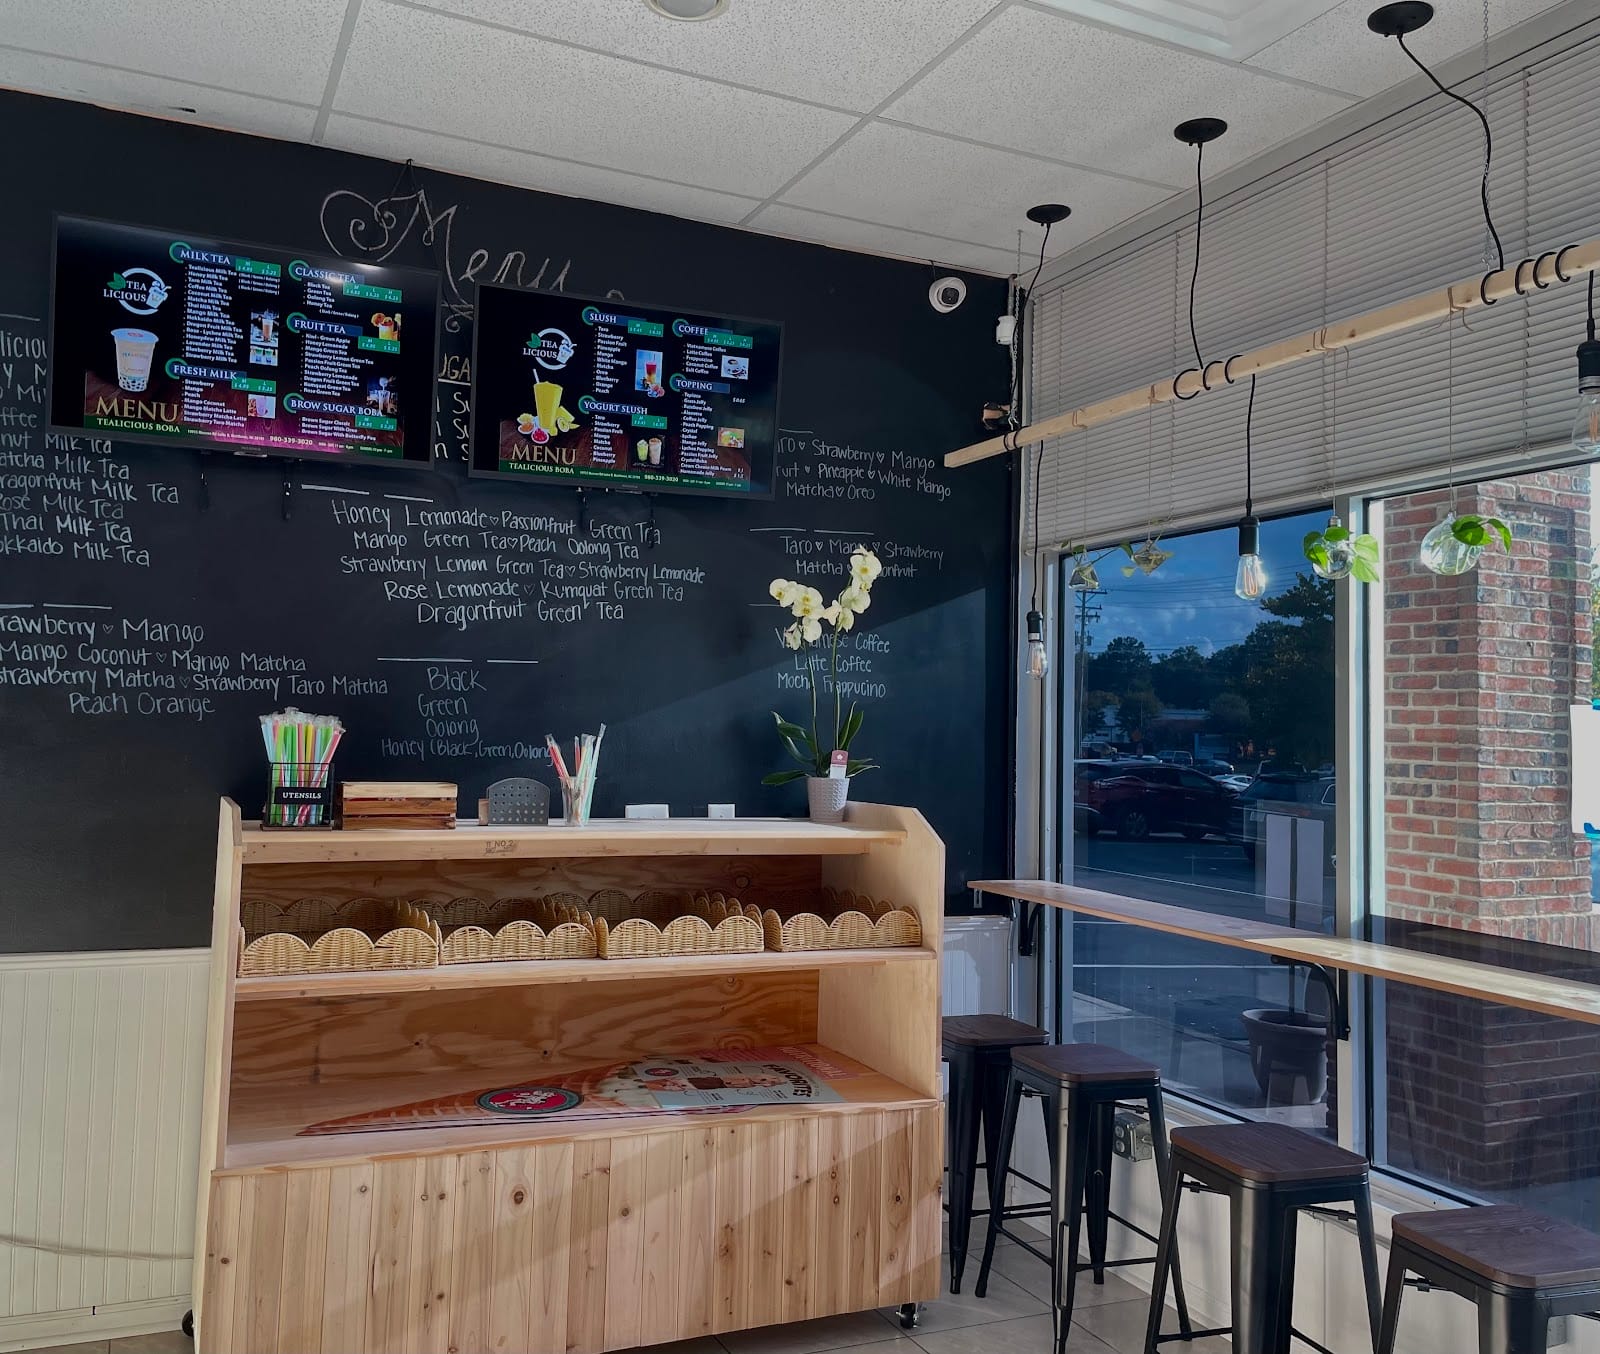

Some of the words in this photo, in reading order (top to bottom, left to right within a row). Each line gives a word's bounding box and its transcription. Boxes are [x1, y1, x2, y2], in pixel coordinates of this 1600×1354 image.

[180, 249, 208, 260] MILK
[210, 253, 230, 264] TEA
[126, 280, 147, 292] TEA
[295, 267, 338, 281] CLASSIC
[338, 273, 356, 284] TEA
[103, 288, 147, 302] LICIOUS
[294, 319, 325, 331] FRUIT
[327, 324, 346, 334] TEA
[589, 312, 617, 324] SLUSH
[678, 324, 709, 336] COFFEE
[523, 347, 558, 359] LICIOUS
[541, 339, 558, 349] TEA
[173, 364, 207, 377] FRESH
[209, 369, 237, 381] MILK
[184, 379, 215, 388] Strawberry
[184, 385, 204, 393] Mango
[675, 379, 713, 391] TOPPING
[95, 395, 180, 423] MENU
[291, 399, 320, 411] BROW
[322, 403, 356, 415] SUGAR
[358, 407, 383, 417] BOBA
[583, 401, 619, 412] YOGURT
[621, 405, 648, 415] SLUSH
[96, 417, 153, 431] TEALICIOUS
[155, 423, 180, 433] BOBA
[511, 443, 577, 465] MENU
[811, 438, 875, 471] Strawberry
[891, 450, 936, 479] Mango
[55, 453, 96, 474] Milk
[99, 459, 130, 480] Tea
[509, 462, 554, 474] TEALICIOUS
[555, 465, 575, 475] BOBA
[92, 479, 138, 502] Milk
[147, 483, 180, 505] Tea
[786, 481, 835, 499] Matcha
[847, 484, 876, 500] Oreo
[817, 462, 865, 484] Pineapple
[878, 469, 912, 489] White
[916, 478, 952, 502] Mango
[43, 493, 88, 513] Milk
[90, 499, 124, 520] Tea
[0, 512, 44, 531] Thai
[56, 514, 96, 538] Milk
[99, 522, 133, 544] Tea
[331, 499, 392, 532] Honey
[404, 503, 488, 529] Lemonade
[501, 510, 577, 537] Passionfruit
[590, 519, 633, 541] Green
[73, 541, 114, 561] Milk
[117, 545, 151, 567] Tea
[353, 530, 408, 556] Mango
[423, 530, 471, 550] Green
[479, 530, 510, 550] Tea
[519, 535, 557, 554] Peach
[567, 537, 613, 563] Oolong
[617, 540, 640, 560] Tea
[779, 535, 814, 555] Taro
[884, 541, 945, 570] Strawberry
[339, 554, 427, 580] Strawberry
[435, 555, 488, 573] Lemon
[495, 554, 535, 574] Green
[538, 558, 564, 579] Tea
[578, 561, 650, 592] Strawberry
[653, 566, 706, 585] Lemonade
[795, 559, 844, 576] Matcha
[384, 580, 428, 602] Rose
[435, 578, 520, 600] Lemonade
[541, 578, 609, 609] Kumquat
[613, 580, 655, 600] Green
[658, 582, 685, 603] Tea
[417, 598, 528, 631] Dragonfruit
[537, 600, 582, 624] Green
[596, 601, 625, 621] Tea
[122, 618, 205, 652] Mango
[855, 630, 890, 653] Coffee
[0, 640, 68, 672] Mango
[78, 642, 153, 667] Coconut
[172, 650, 230, 678] Mango
[240, 651, 307, 673] Matcha
[835, 653, 873, 673] Coffee
[105, 667, 175, 690] Matcha
[193, 674, 281, 702] Strawberry
[287, 676, 326, 696] Taro
[332, 676, 389, 696] Matcha
[426, 665, 487, 692] Black
[777, 672, 812, 690] Moch
[823, 674, 887, 699] Frappucino
[68, 692, 129, 716] Peach
[137, 692, 216, 722] Orange
[417, 693, 468, 717] Green
[425, 718, 480, 747] Oolong
[381, 738, 425, 762] Honey
[282, 791, 322, 800] UTENSILS
[762, 1063, 813, 1098] FAVORITES
